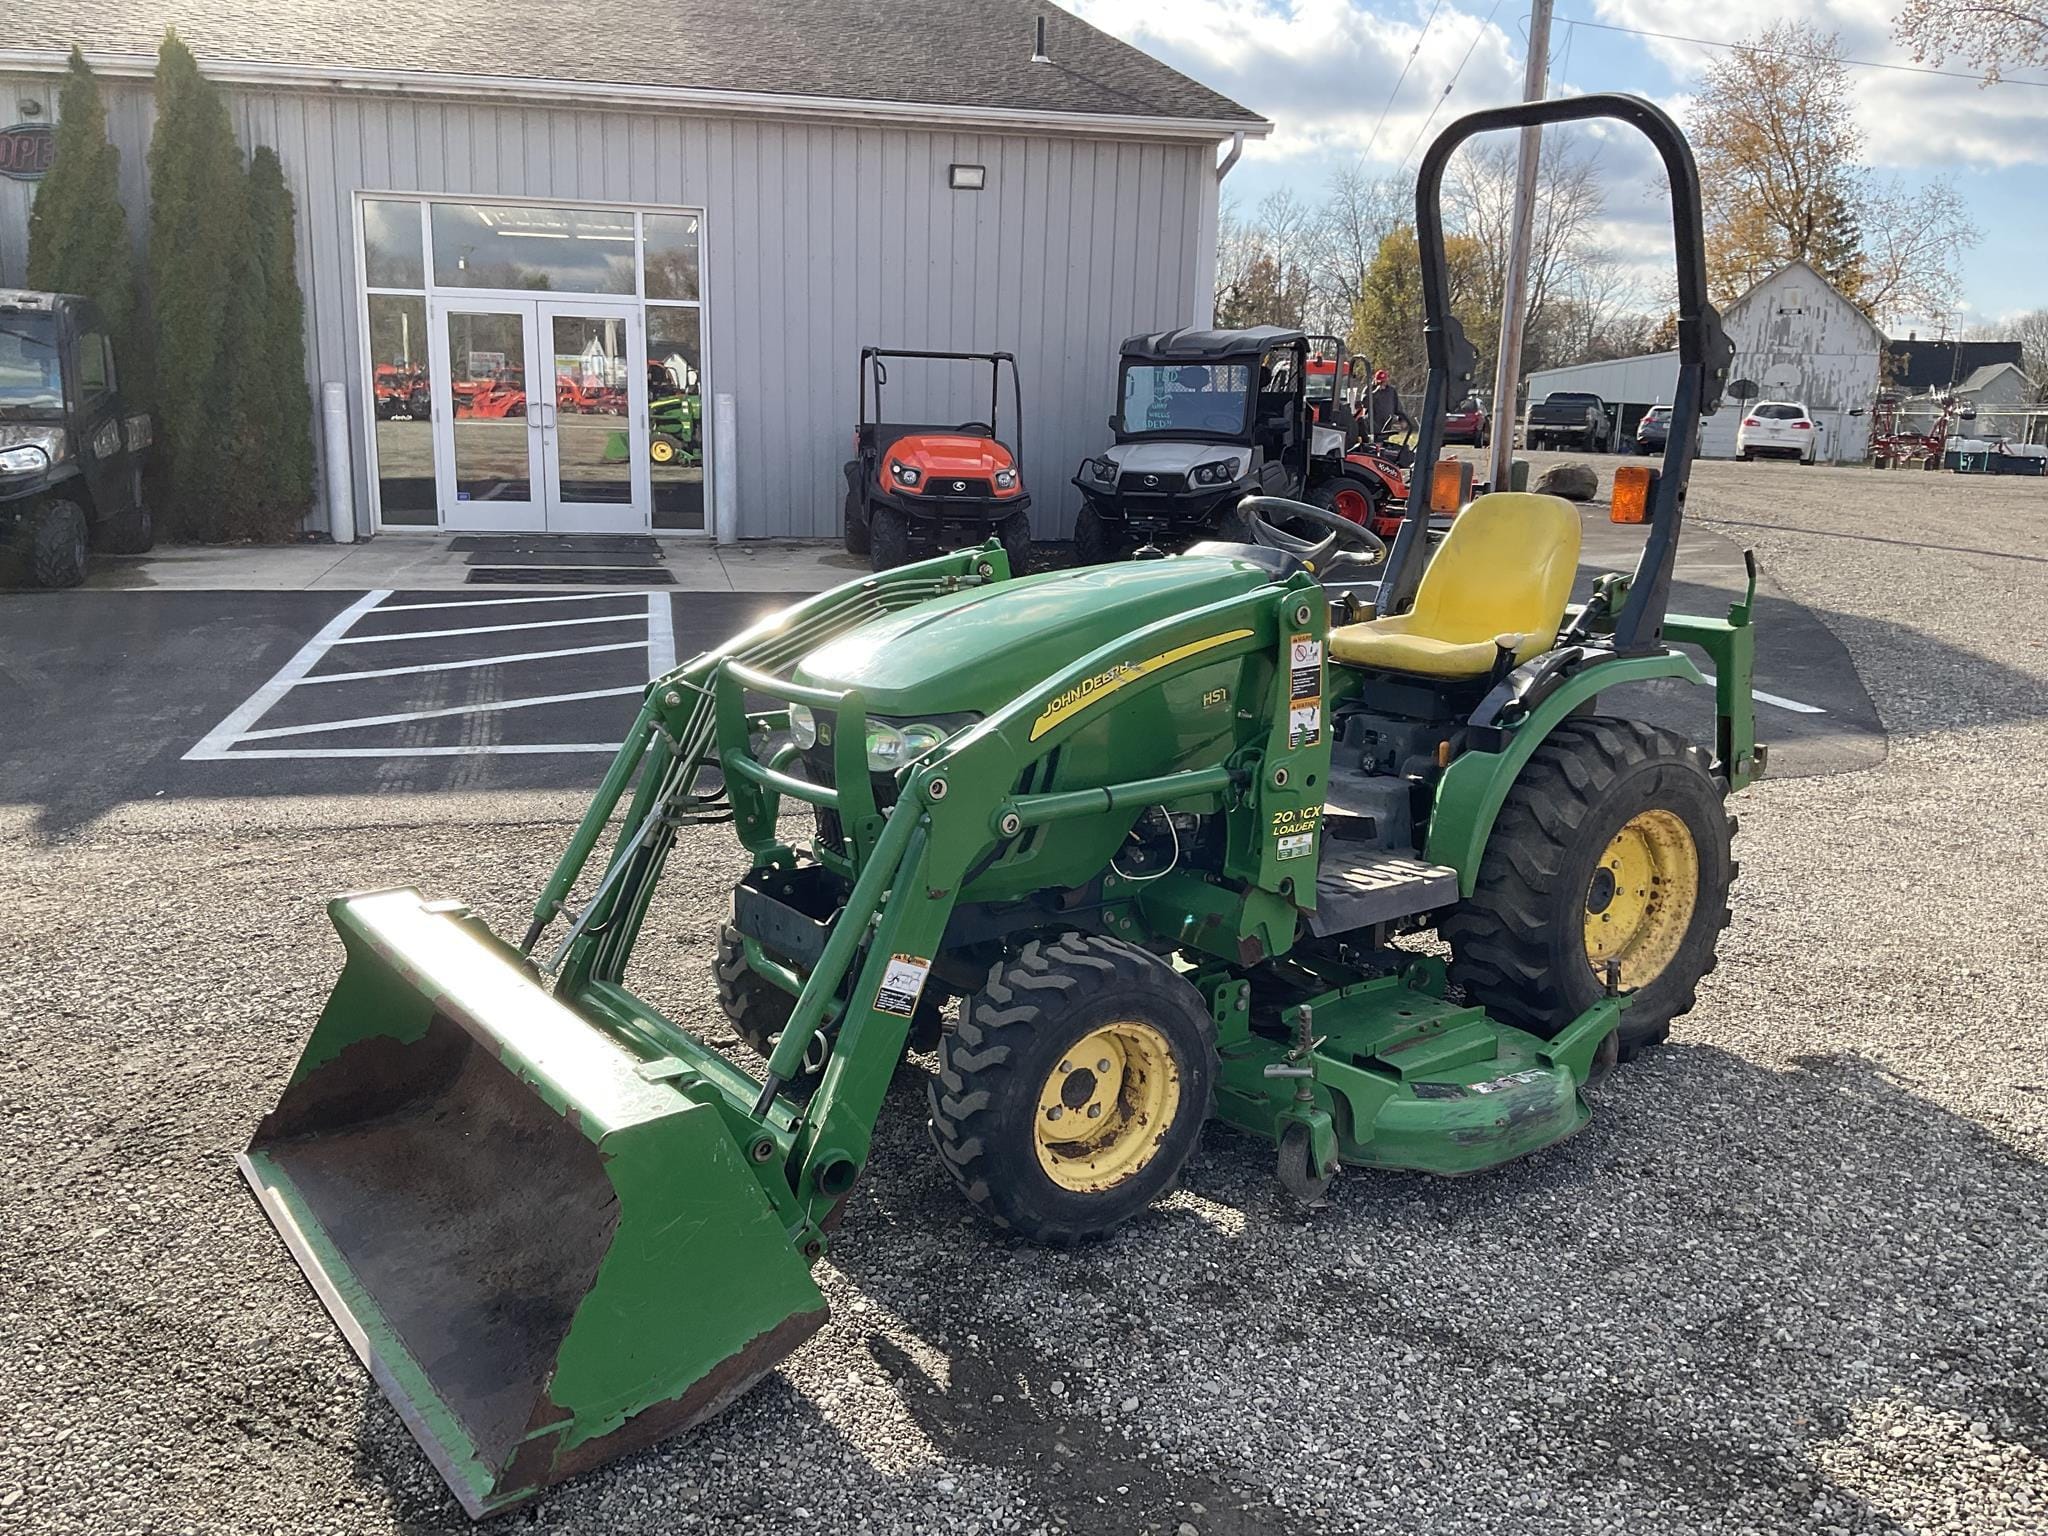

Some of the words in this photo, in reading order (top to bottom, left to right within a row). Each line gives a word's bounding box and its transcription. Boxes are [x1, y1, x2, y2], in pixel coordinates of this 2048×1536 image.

[0, 134, 56, 169] OPE
[1042, 686, 1081, 718] JOHN
[1273, 820, 1316, 836] LOADER
